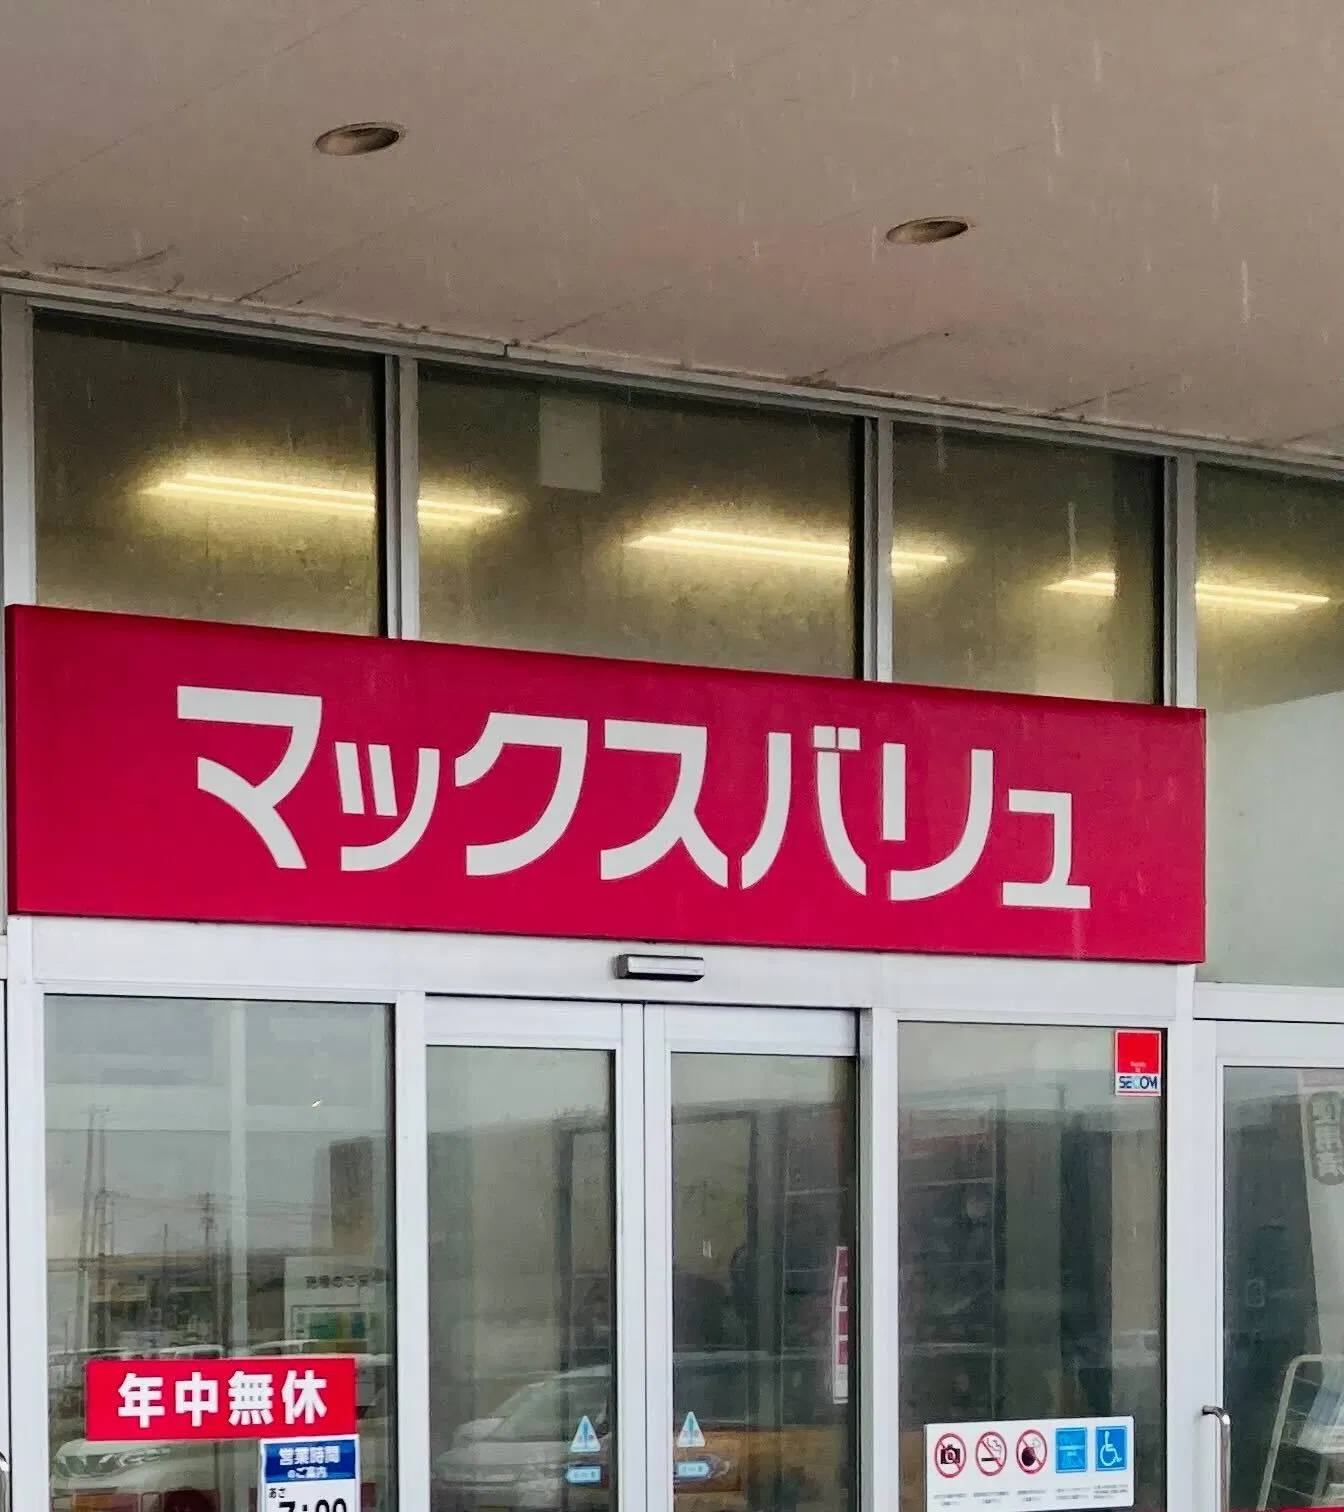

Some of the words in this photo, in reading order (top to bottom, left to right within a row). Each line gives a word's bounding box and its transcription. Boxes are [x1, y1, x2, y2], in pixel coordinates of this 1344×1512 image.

[176, 686, 1091, 910] マックスバリュ
[1119, 1075, 1158, 1090] SEOM
[117, 1369, 328, 1428] 年中無休
[279, 1445, 341, 1466] 営業時間
[268, 1486, 287, 1499] あさ
